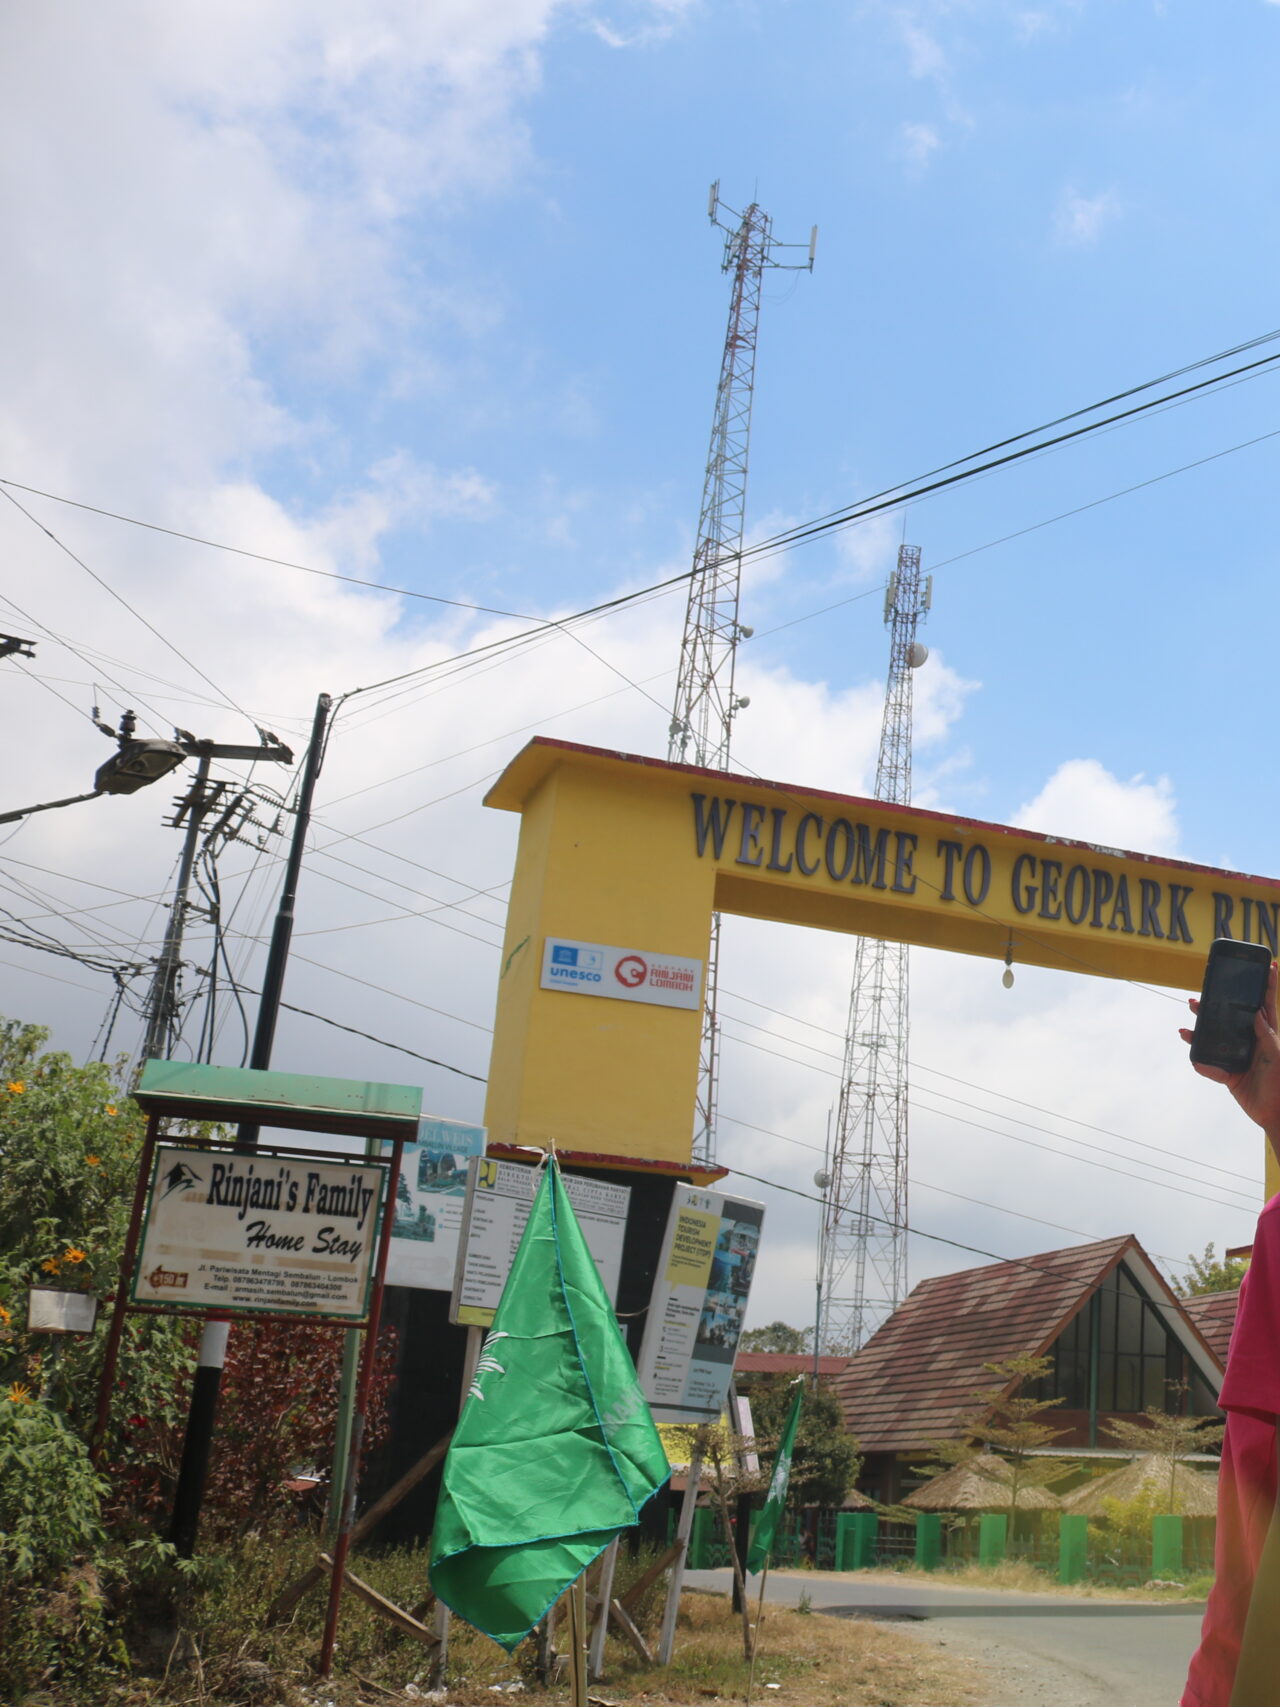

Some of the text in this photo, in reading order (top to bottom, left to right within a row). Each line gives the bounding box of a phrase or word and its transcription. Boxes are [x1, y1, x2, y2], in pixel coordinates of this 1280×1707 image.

[691, 792, 918, 895] WELCOME
[937, 839, 992, 905] TO
[1011, 854, 1194, 943] GEOPARK
[550, 966, 602, 983] unesco
[206, 1162, 299, 1220] Rinjani's
[303, 1172, 374, 1230] Family
[246, 1221, 363, 1263] Home Stay
